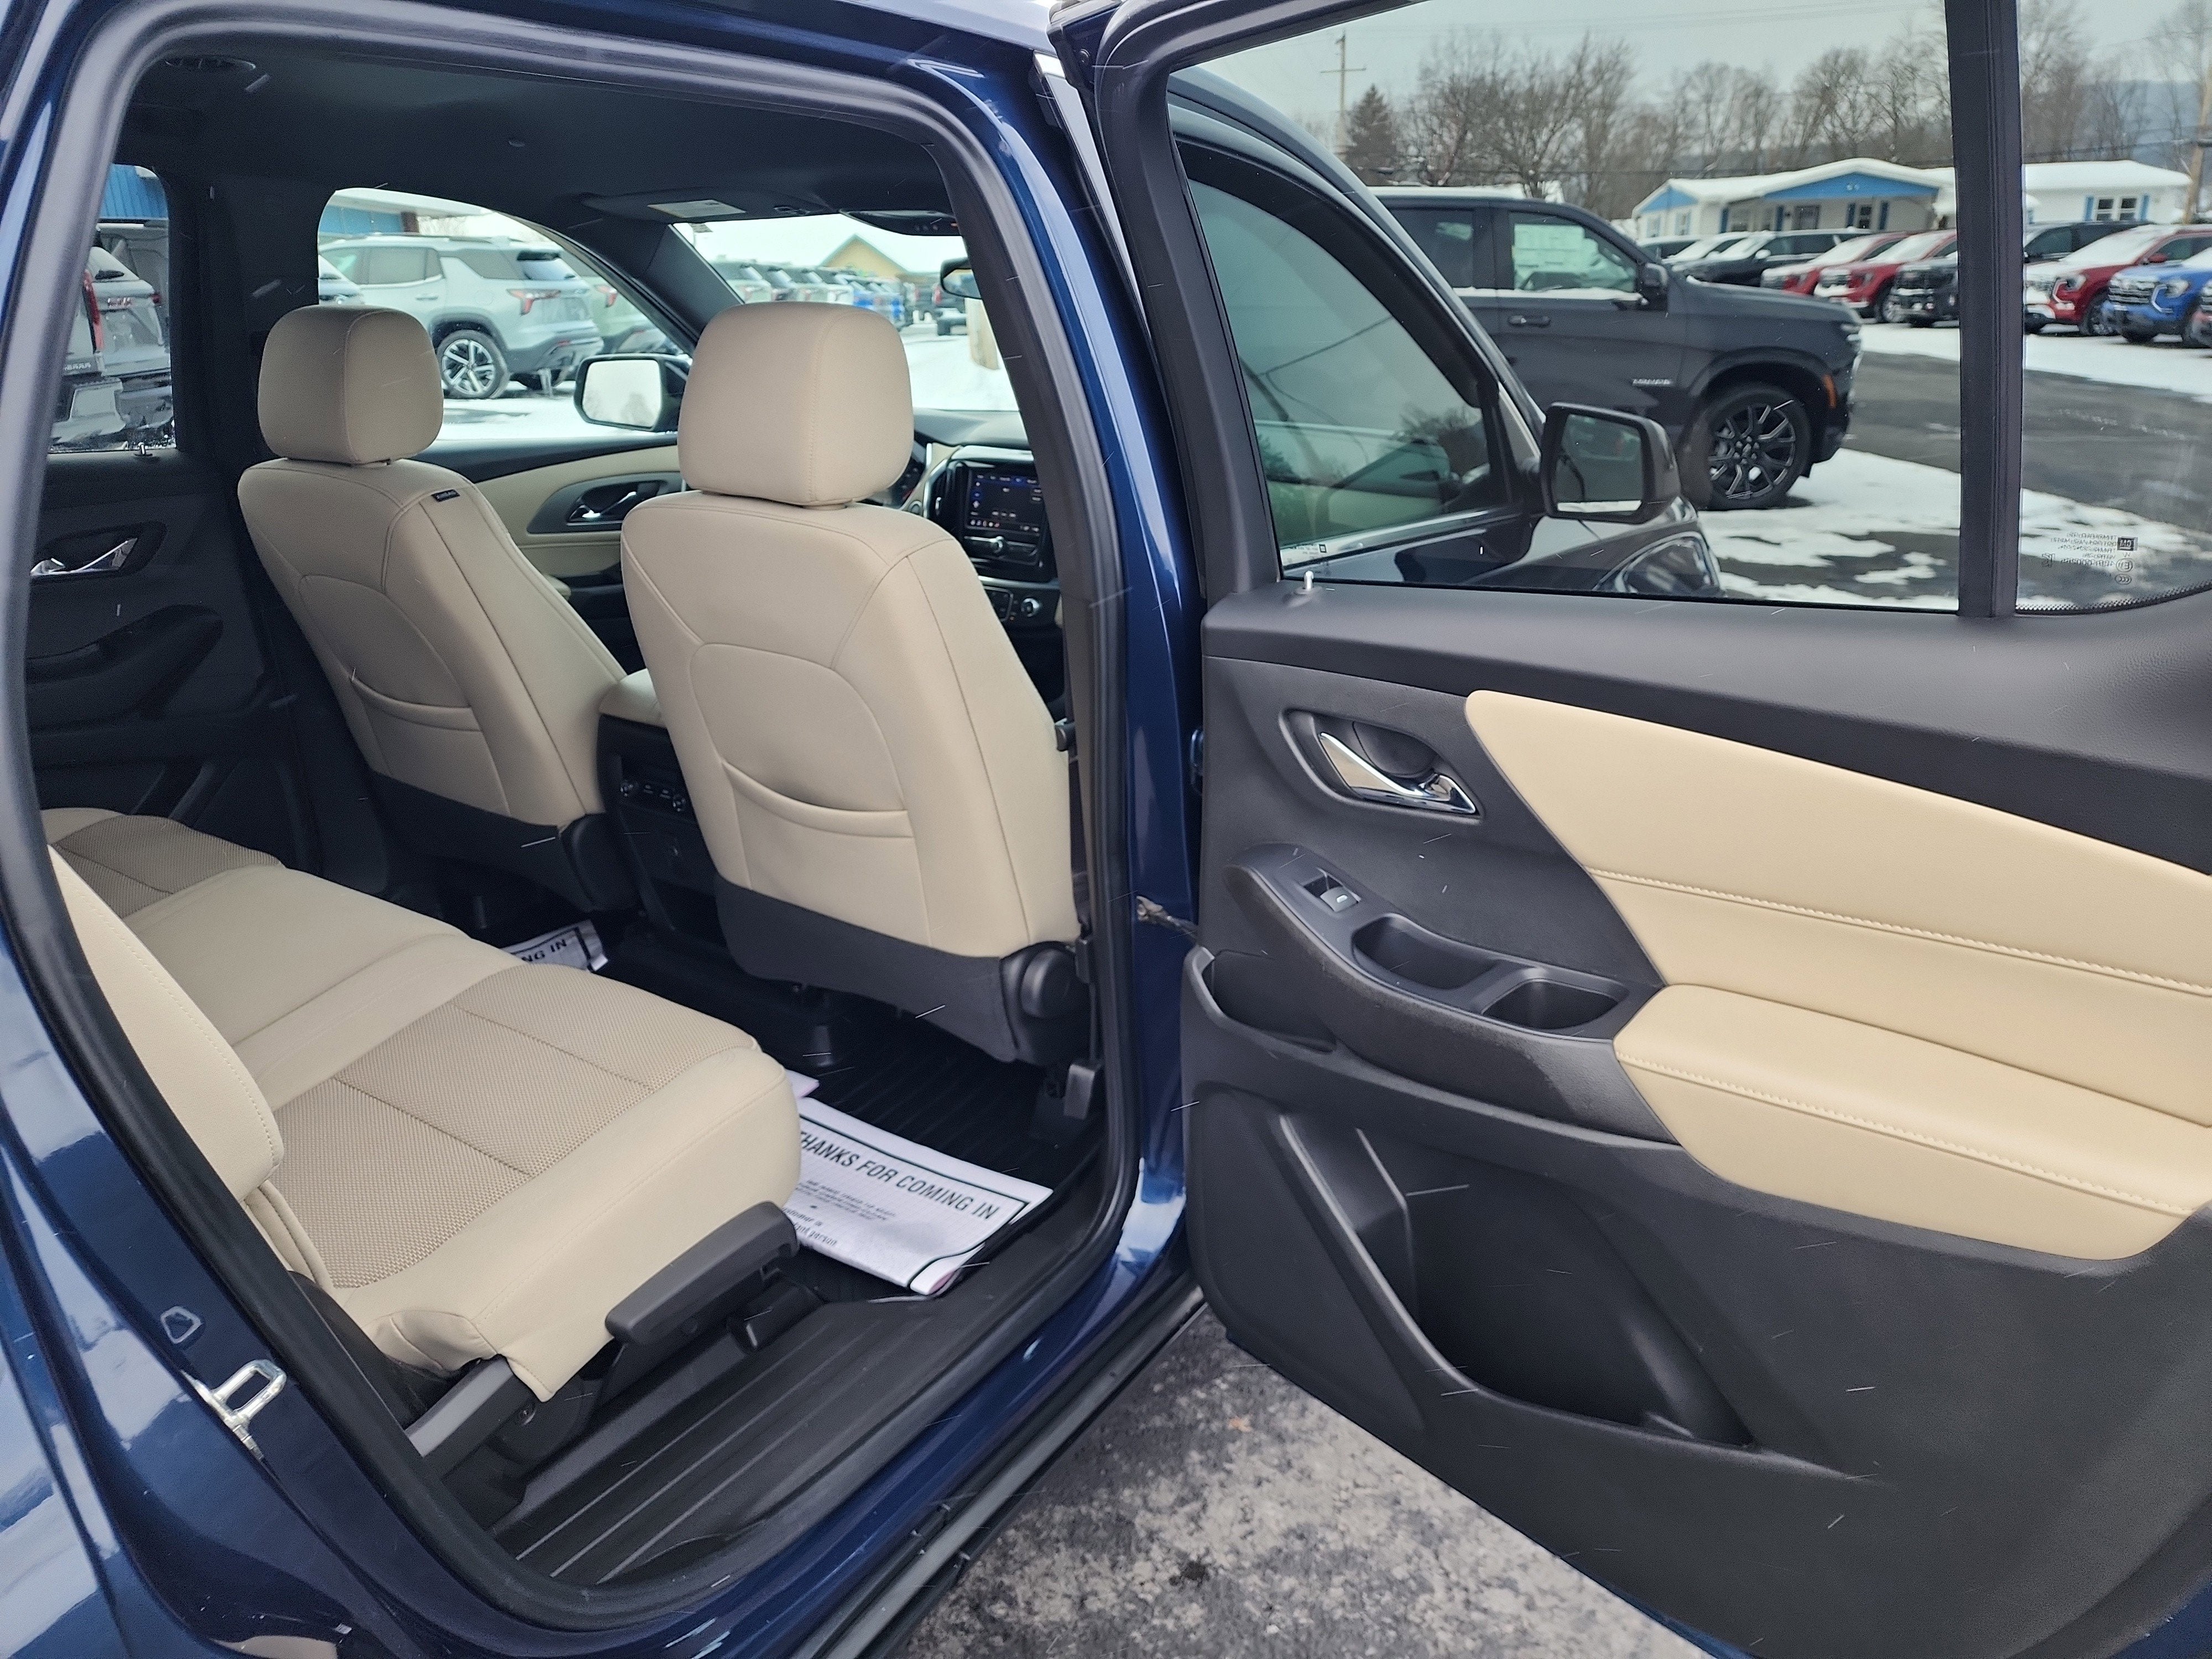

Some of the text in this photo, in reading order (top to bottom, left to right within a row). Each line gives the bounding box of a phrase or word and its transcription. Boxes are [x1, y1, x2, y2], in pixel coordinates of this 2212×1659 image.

[550, 939, 567, 952] IN
[855, 1160, 899, 1182] FOR
[896, 1175, 974, 1211] COMING
[972, 1202, 1000, 1220] IN
